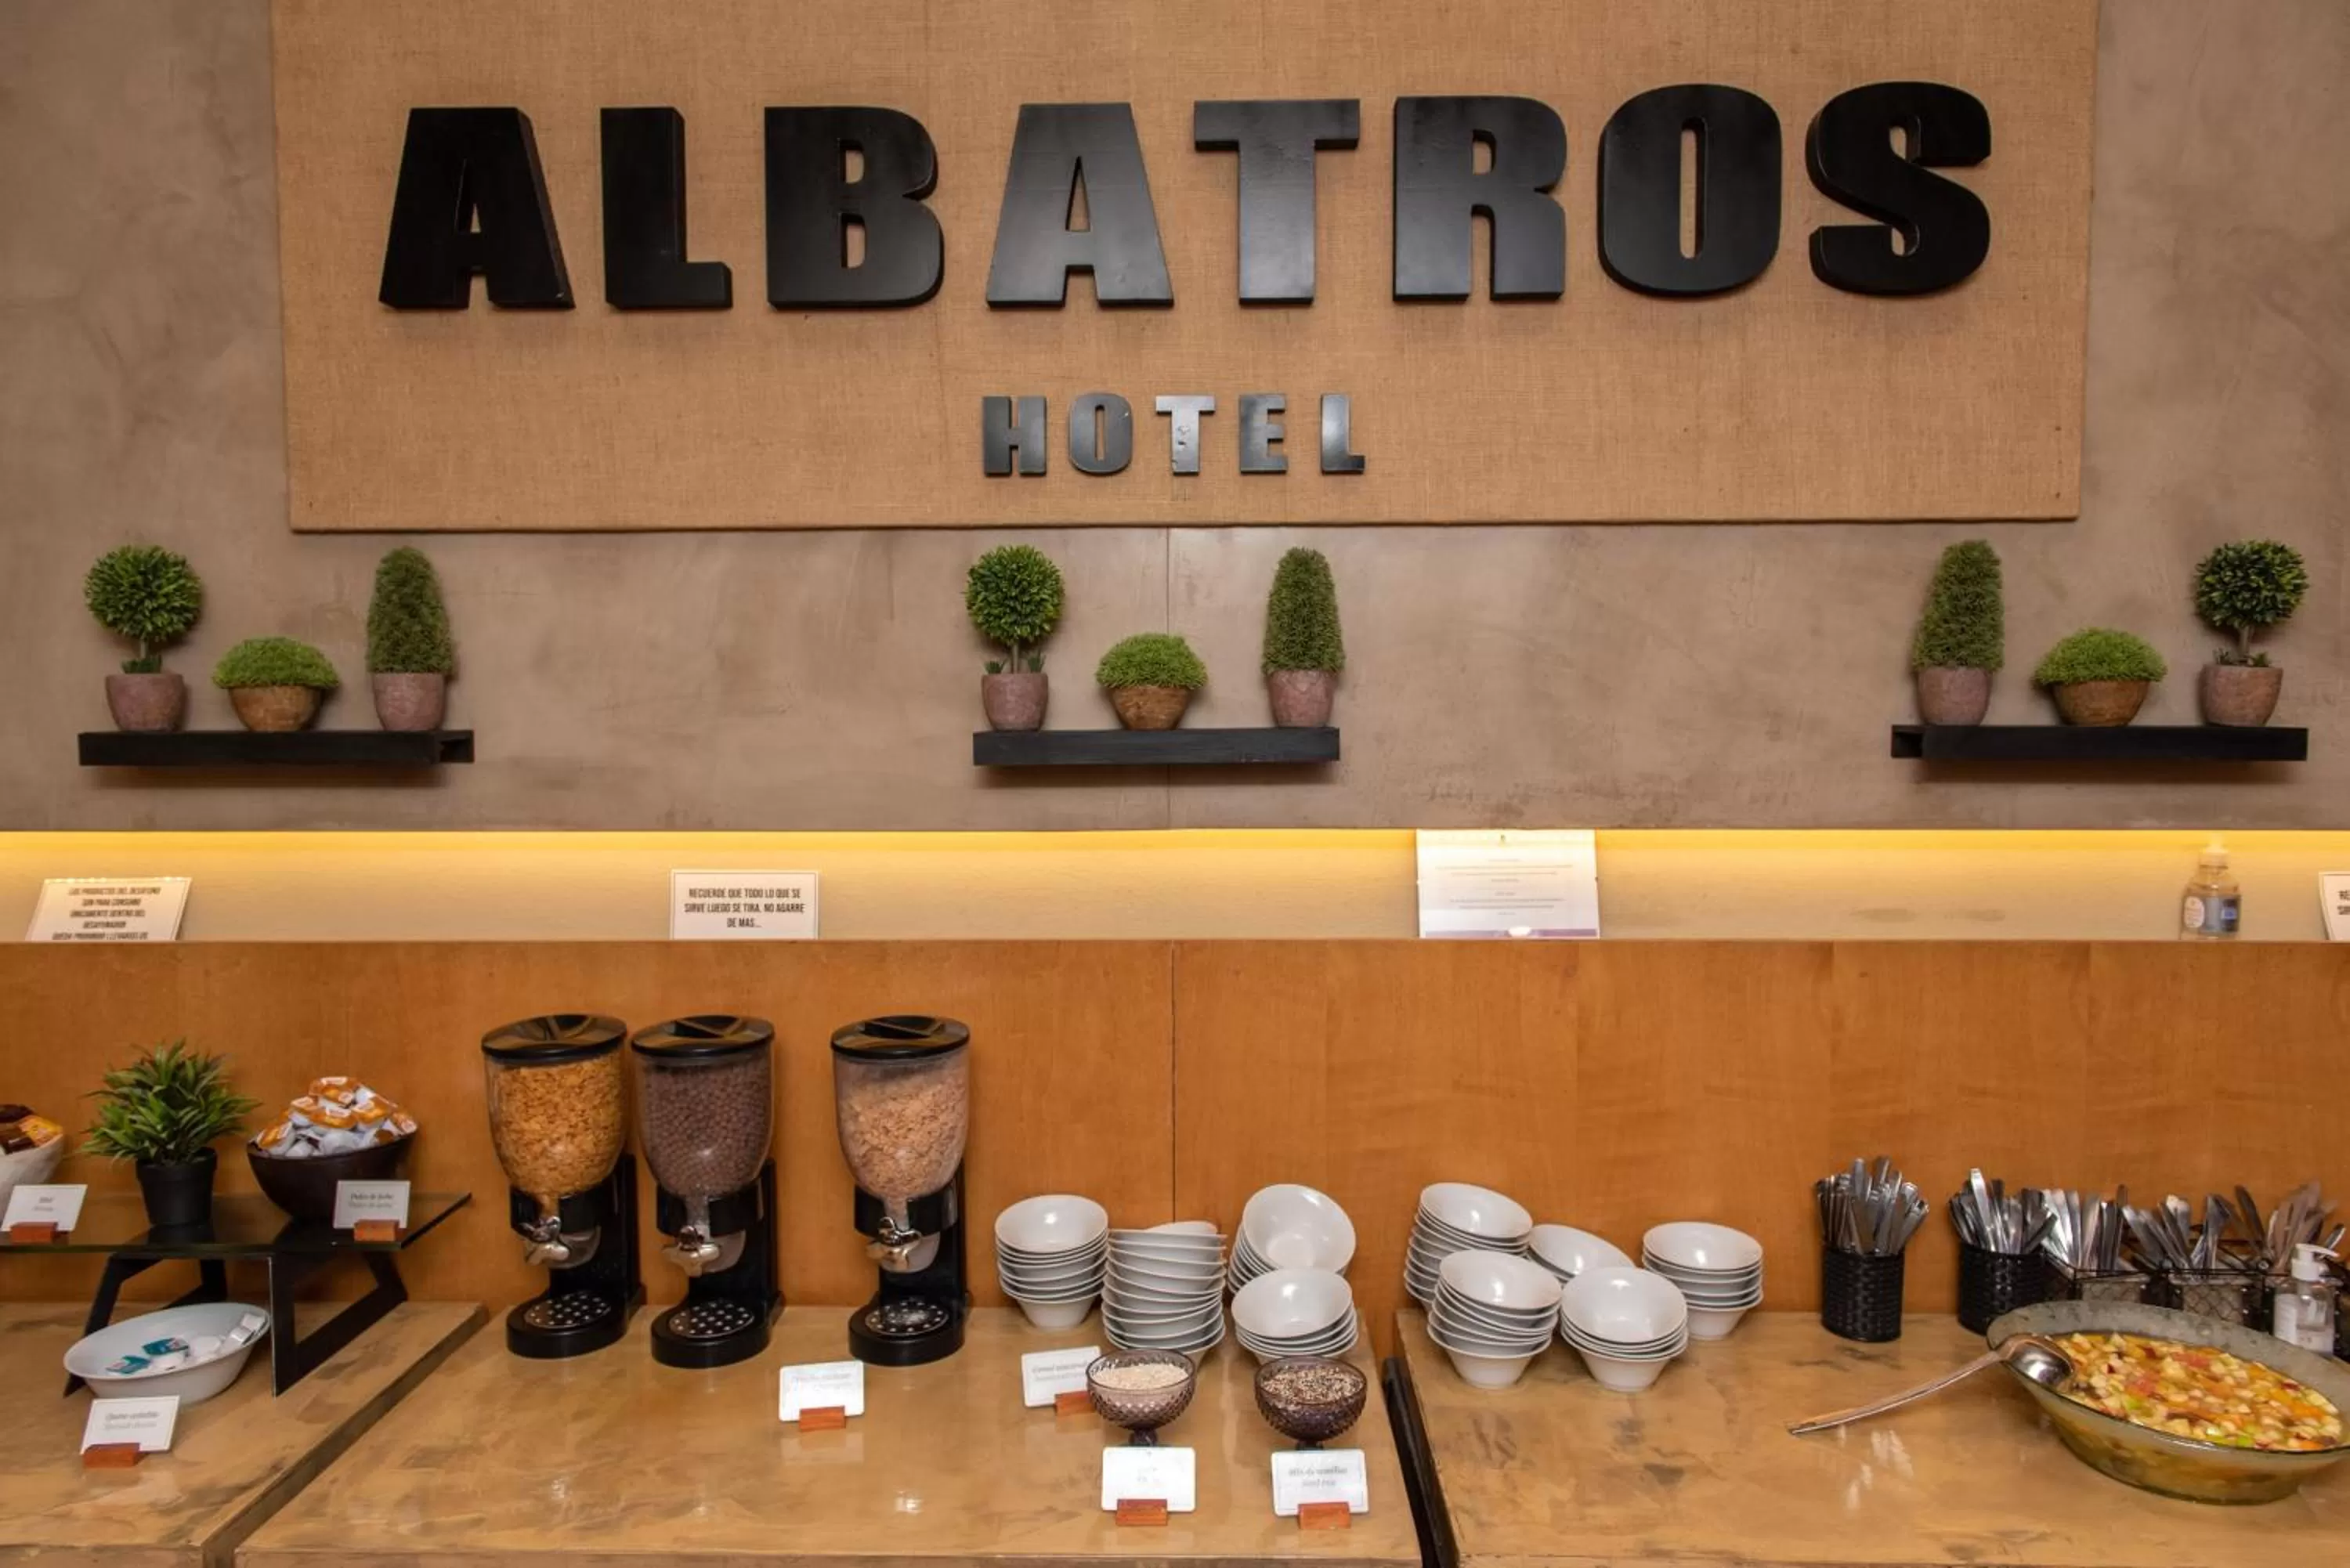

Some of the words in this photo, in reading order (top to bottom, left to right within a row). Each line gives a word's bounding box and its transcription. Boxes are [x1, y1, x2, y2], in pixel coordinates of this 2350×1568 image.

[378, 81, 1991, 309] ALBATROS
[982, 392, 1365, 476] HOTEL
[689, 888, 725, 898] RECUERDE
[728, 888, 743, 898] QUE
[744, 888, 764, 898] TODO
[765, 888, 774, 898] LO
[776, 888, 790, 898] QUE
[792, 888, 801, 898] SE
[684, 903, 706, 913] SIRVE
[707, 903, 731, 913] LUEGO
[732, 903, 741, 913] SE
[764, 903, 774, 913] NO
[776, 903, 805, 913] AGARRE
[727, 918, 736, 928] DE
